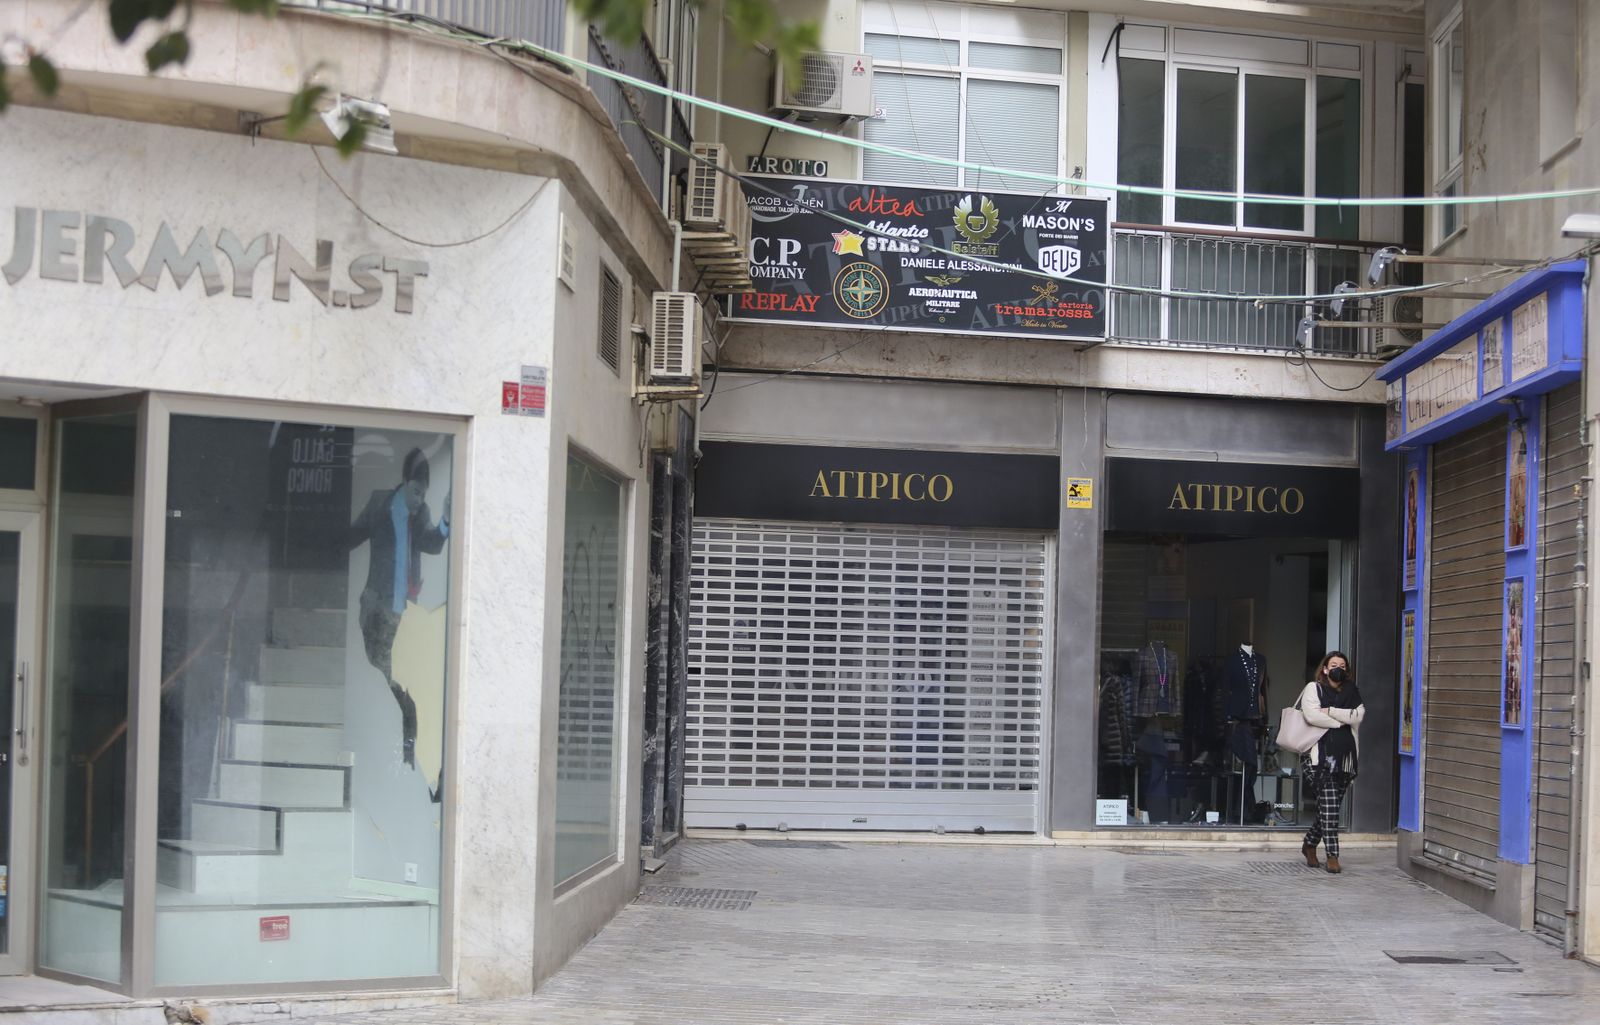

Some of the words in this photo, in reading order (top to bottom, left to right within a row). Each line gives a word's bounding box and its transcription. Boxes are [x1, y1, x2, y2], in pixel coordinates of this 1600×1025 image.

[749, 156, 827, 177] ARQTO
[747, 196, 781, 207] JACOB
[848, 188, 925, 217] altea
[866, 220, 929, 238] Atlantic
[1022, 214, 1096, 232] MASON'S
[867, 236, 921, 254] STARS
[900, 257, 945, 269] DANIELE
[1042, 249, 1078, 273] DEUS
[739, 292, 821, 313] REPLAY
[908, 287, 978, 300] AERONAUTICA
[925, 300, 961, 308] MILITARE
[994, 303, 1094, 319] tramarossa
[1058, 301, 1094, 310] sartoria
[808, 469, 954, 503] ATIPICO
[1167, 482, 1306, 515] ATIPICO
